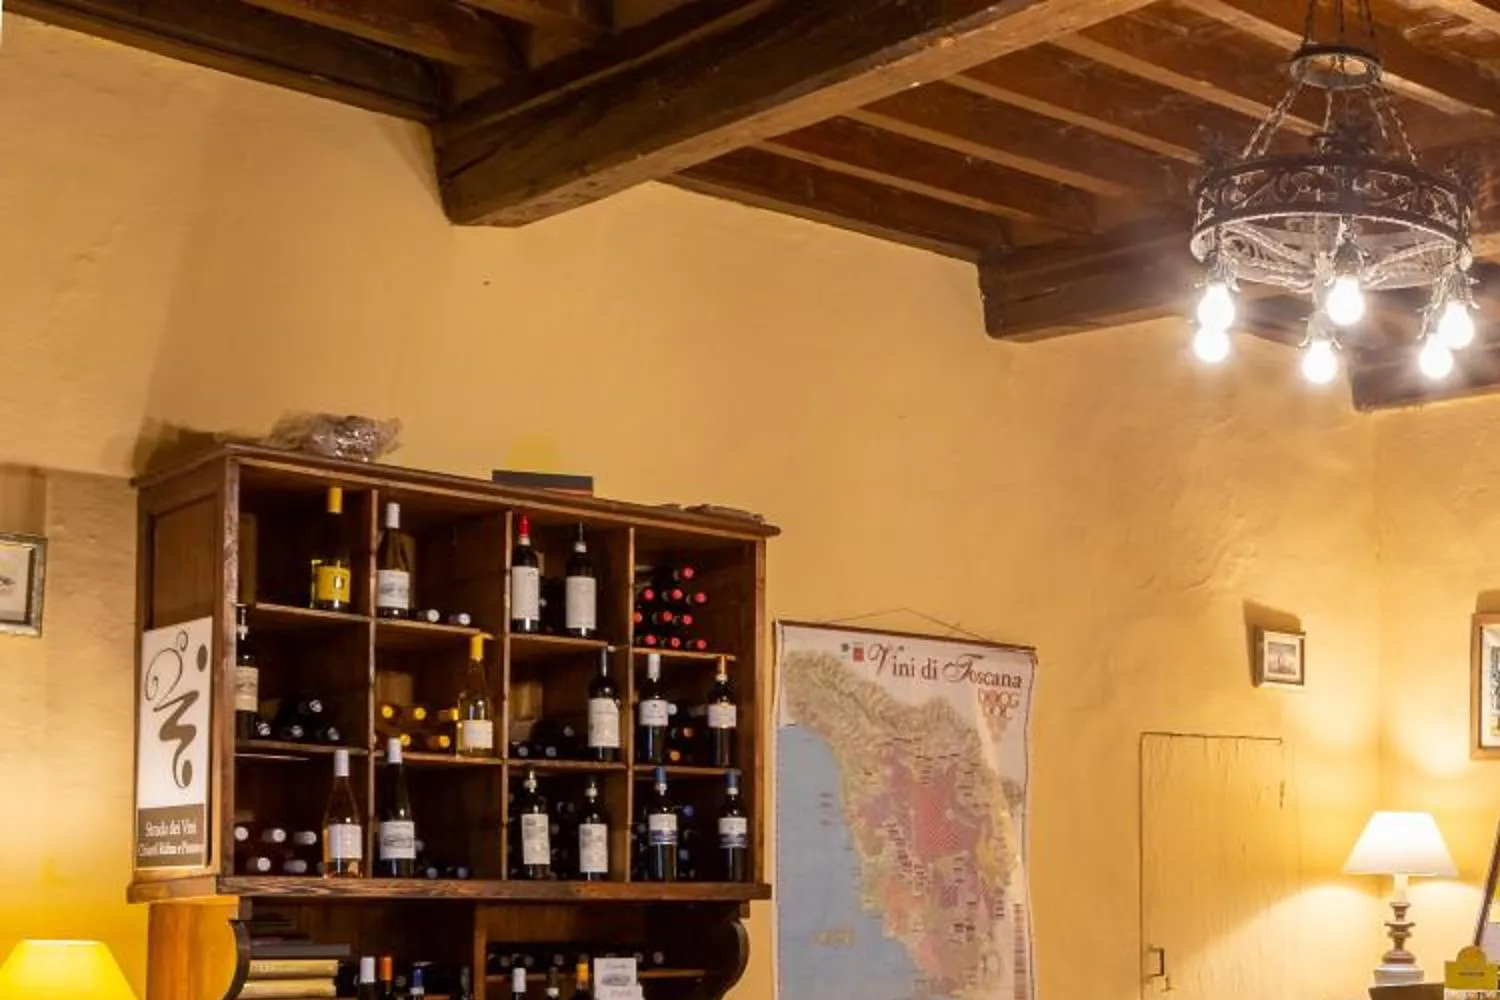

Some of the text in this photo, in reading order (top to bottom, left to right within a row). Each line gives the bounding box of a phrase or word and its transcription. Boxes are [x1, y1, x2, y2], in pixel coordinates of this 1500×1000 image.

[867, 643, 1022, 689] Vini di Toscana
